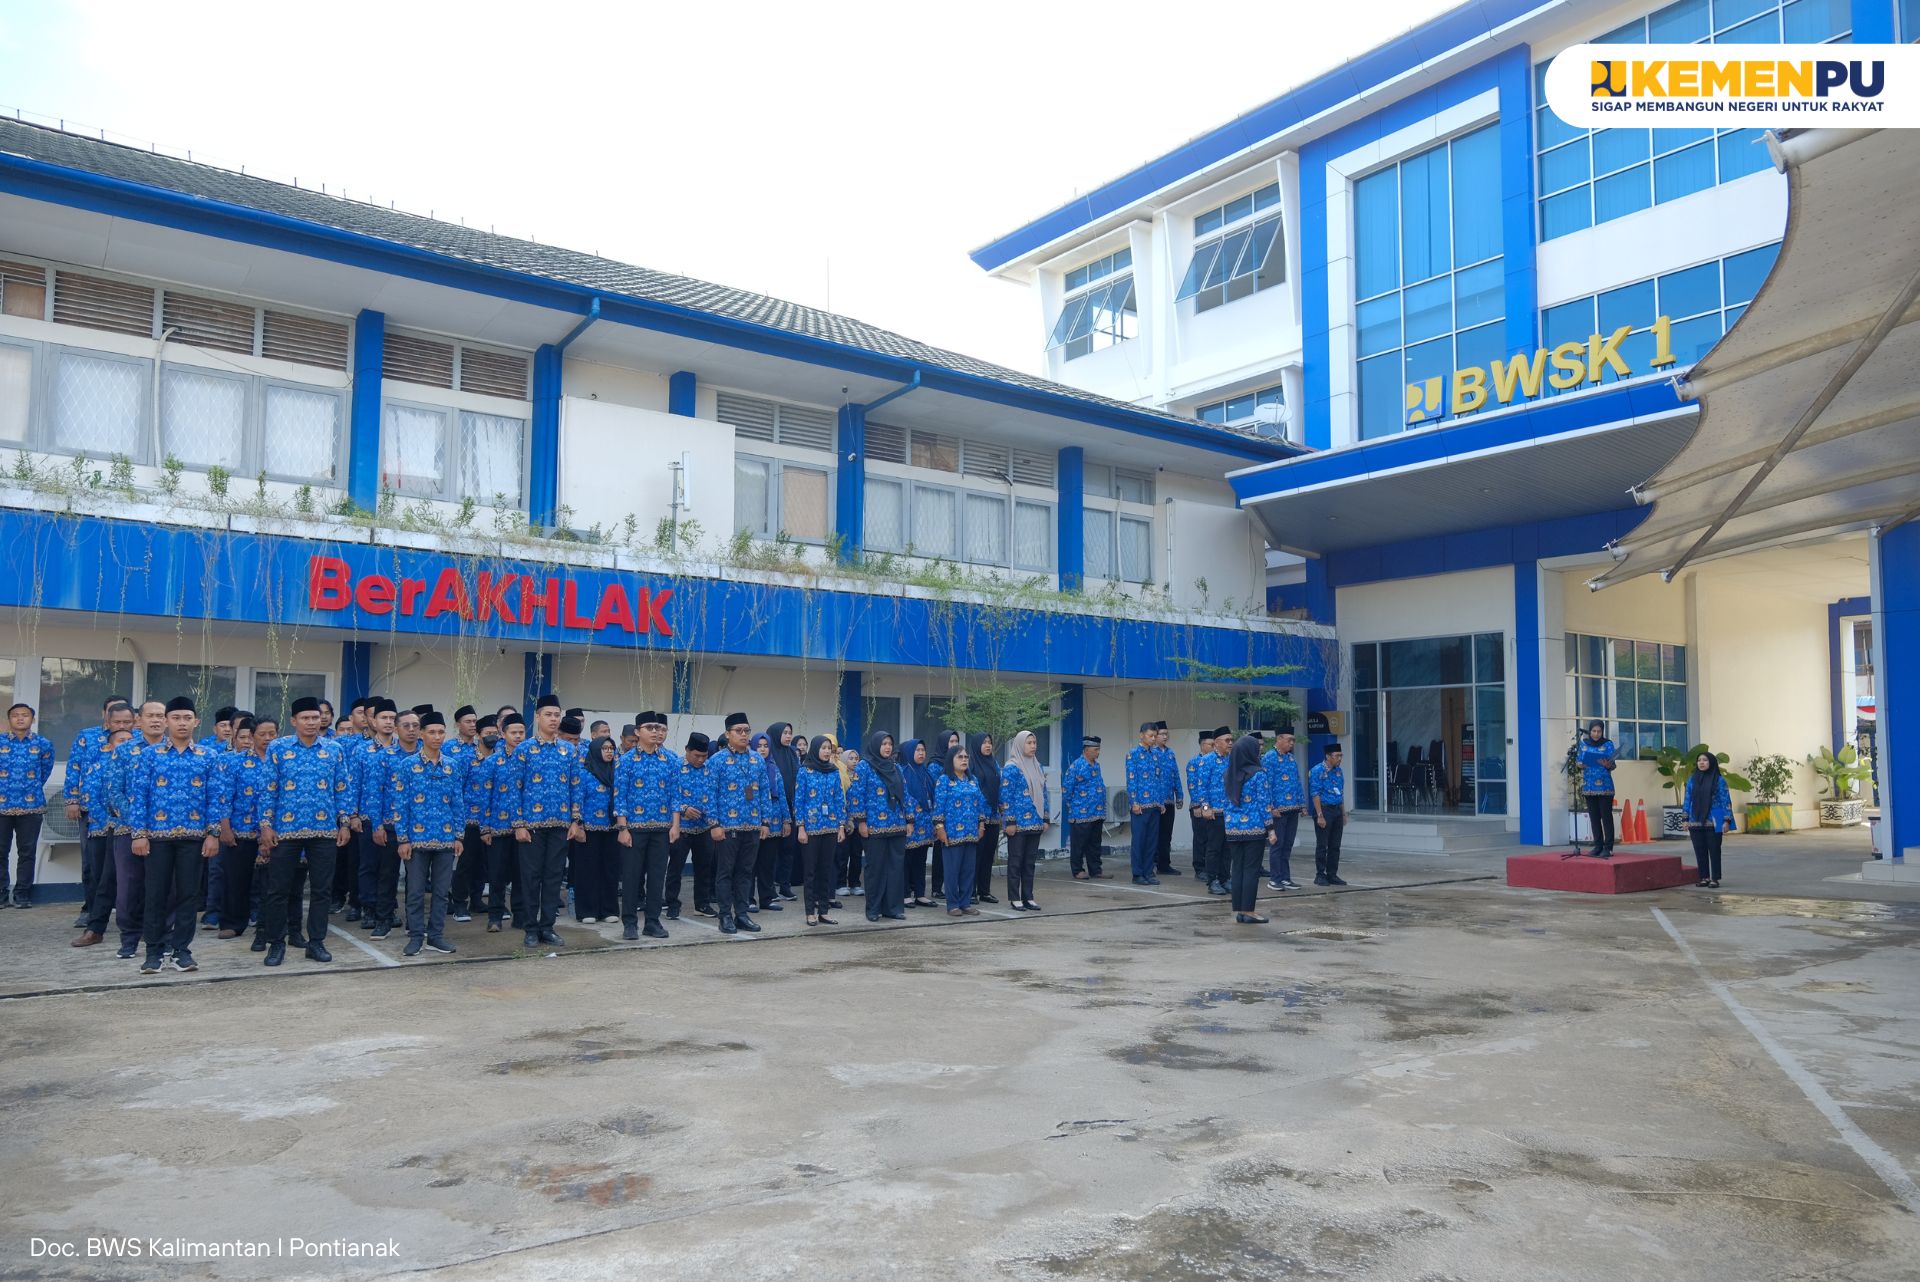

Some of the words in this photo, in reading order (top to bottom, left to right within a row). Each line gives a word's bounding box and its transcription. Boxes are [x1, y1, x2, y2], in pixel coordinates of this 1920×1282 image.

[1451, 325, 1633, 415] BWSK
[1650, 315, 1677, 368] 1
[309, 555, 674, 636] BerAKHLAK
